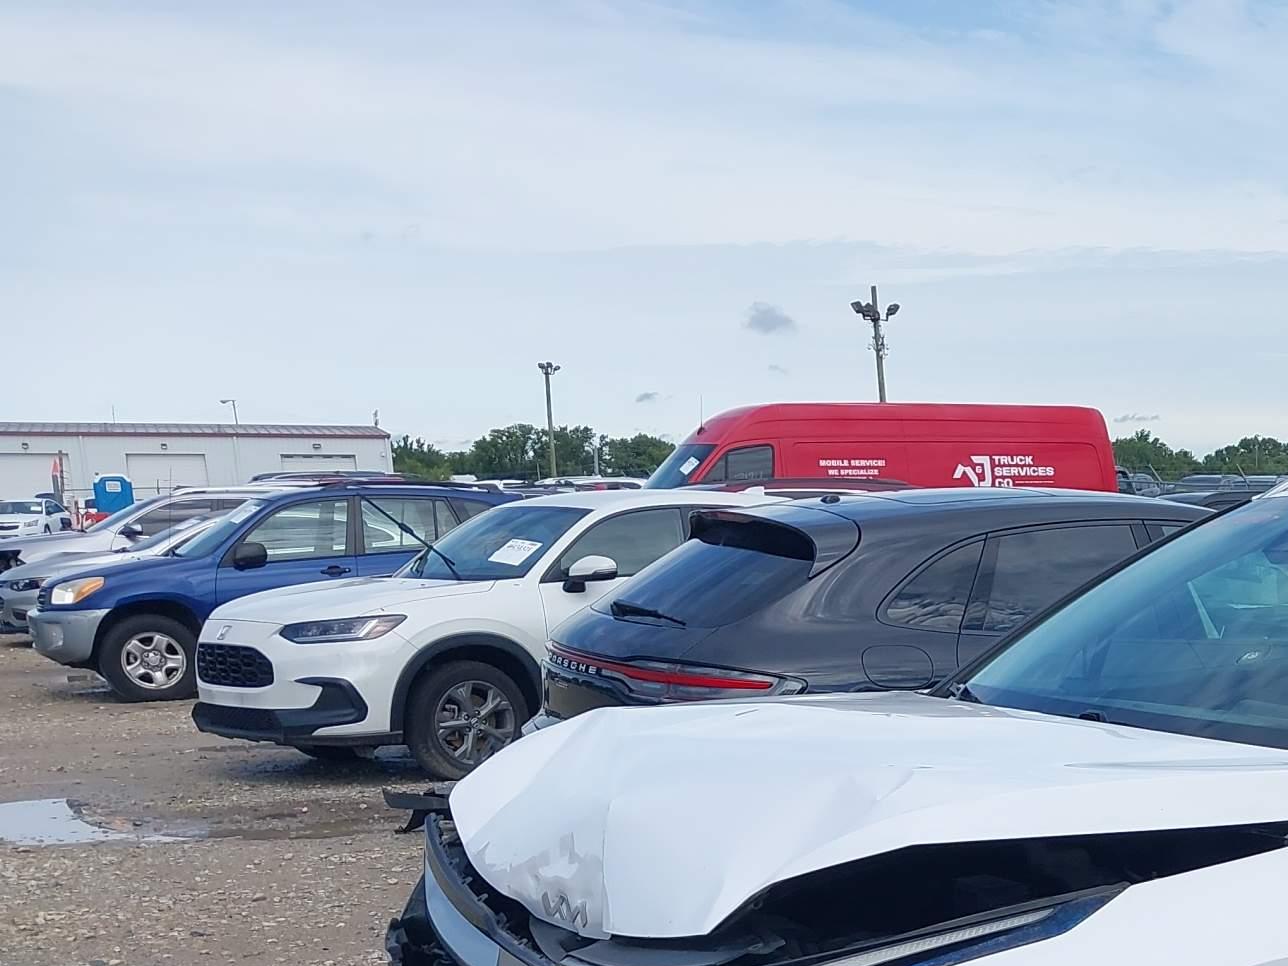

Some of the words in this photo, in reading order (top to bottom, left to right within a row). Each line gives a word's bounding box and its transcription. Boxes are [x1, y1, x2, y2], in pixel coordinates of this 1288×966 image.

[819, 459, 849, 467] MOBILE
[992, 455, 1034, 465] TRUCK
[994, 466, 1055, 476] SERVICES
